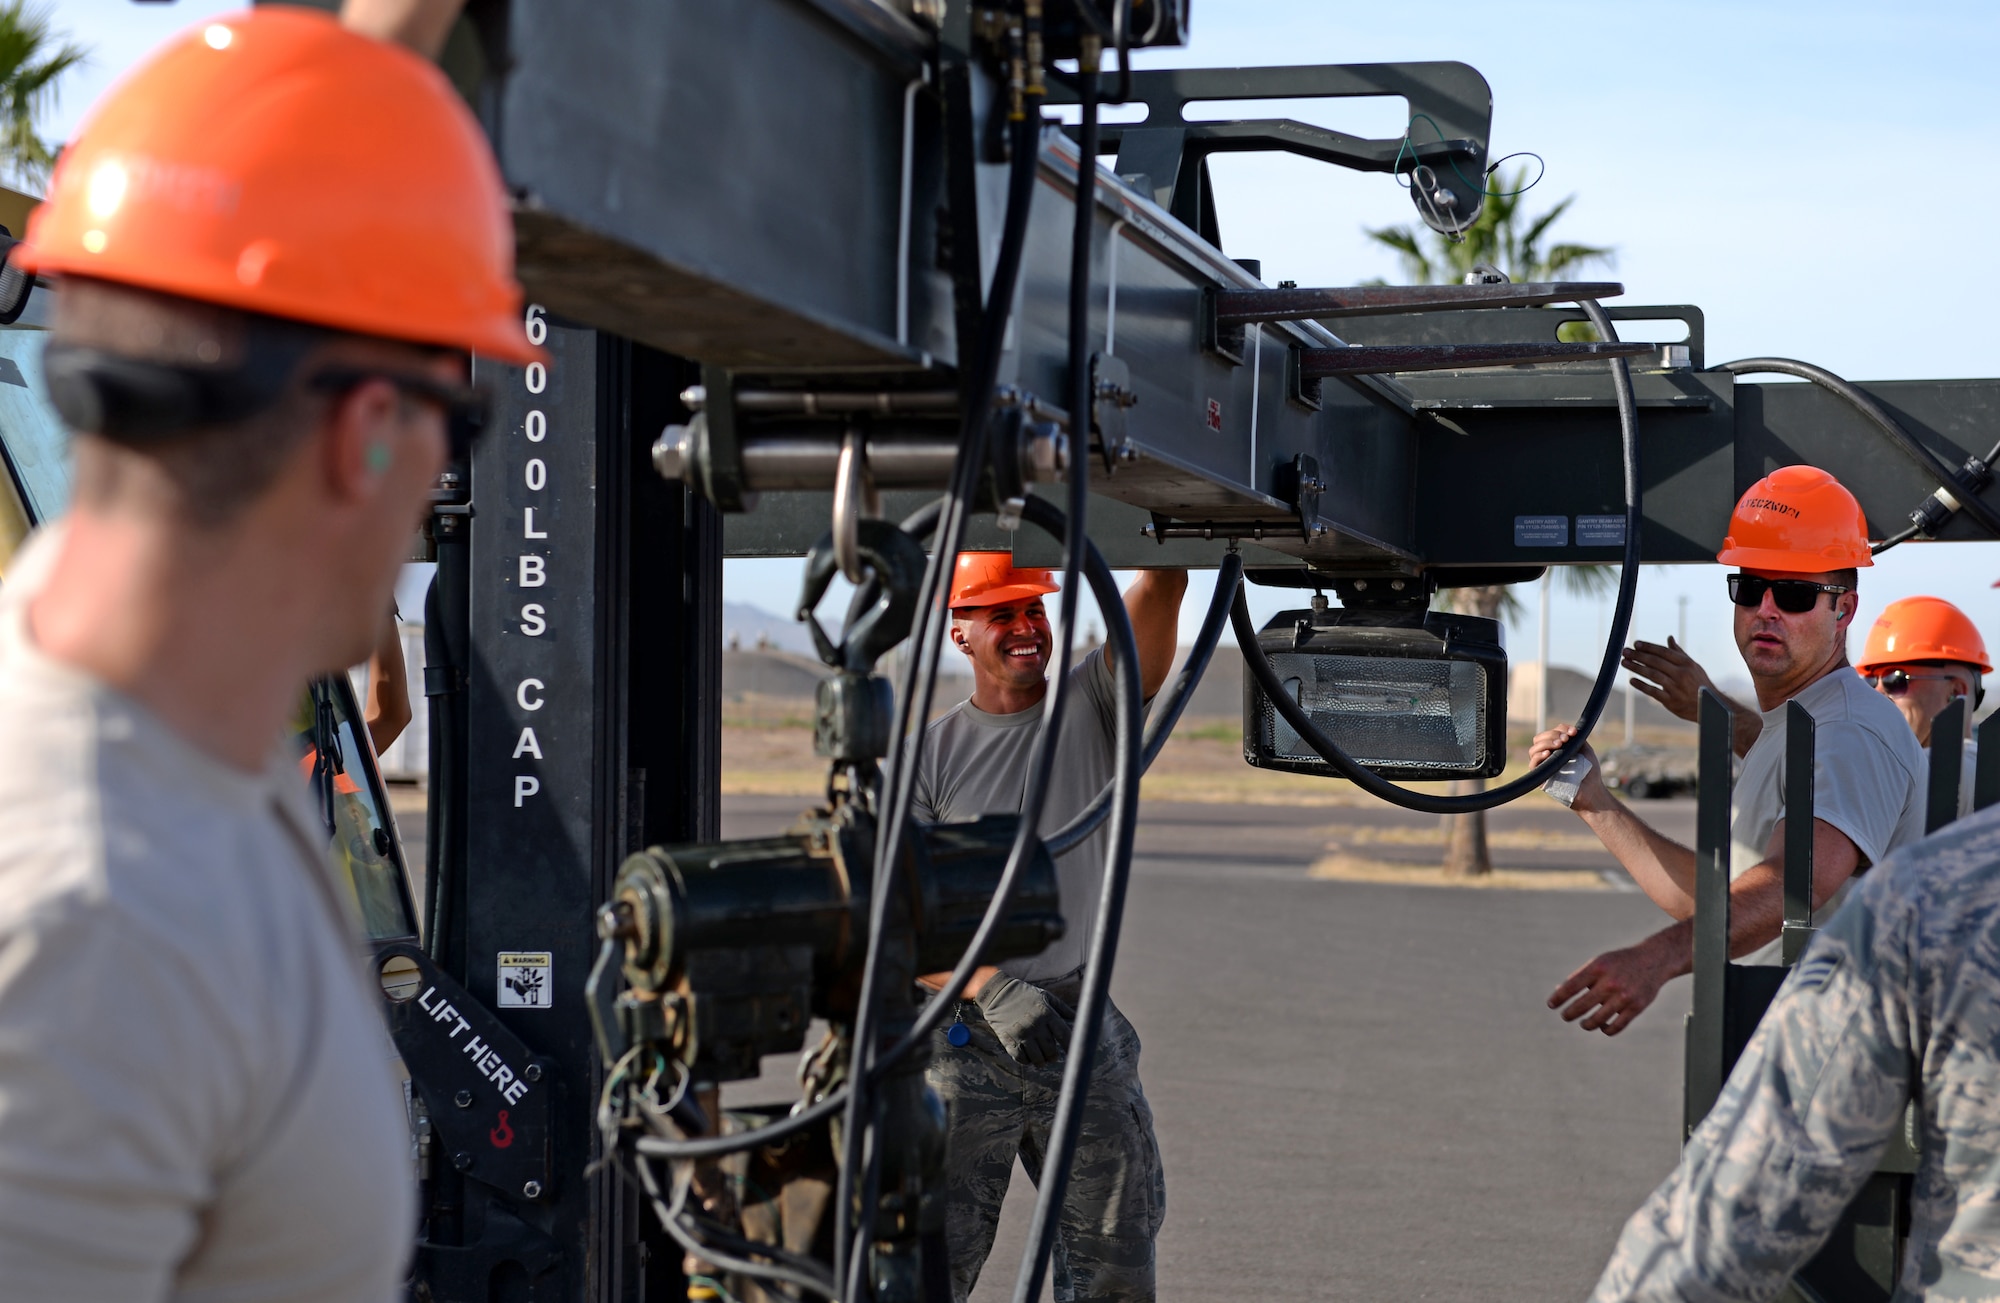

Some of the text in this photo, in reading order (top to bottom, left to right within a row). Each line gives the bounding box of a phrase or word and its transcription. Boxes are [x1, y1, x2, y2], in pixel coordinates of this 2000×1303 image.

[512, 678, 545, 808] CAP
[418, 986, 529, 1106] LIFT HERE
